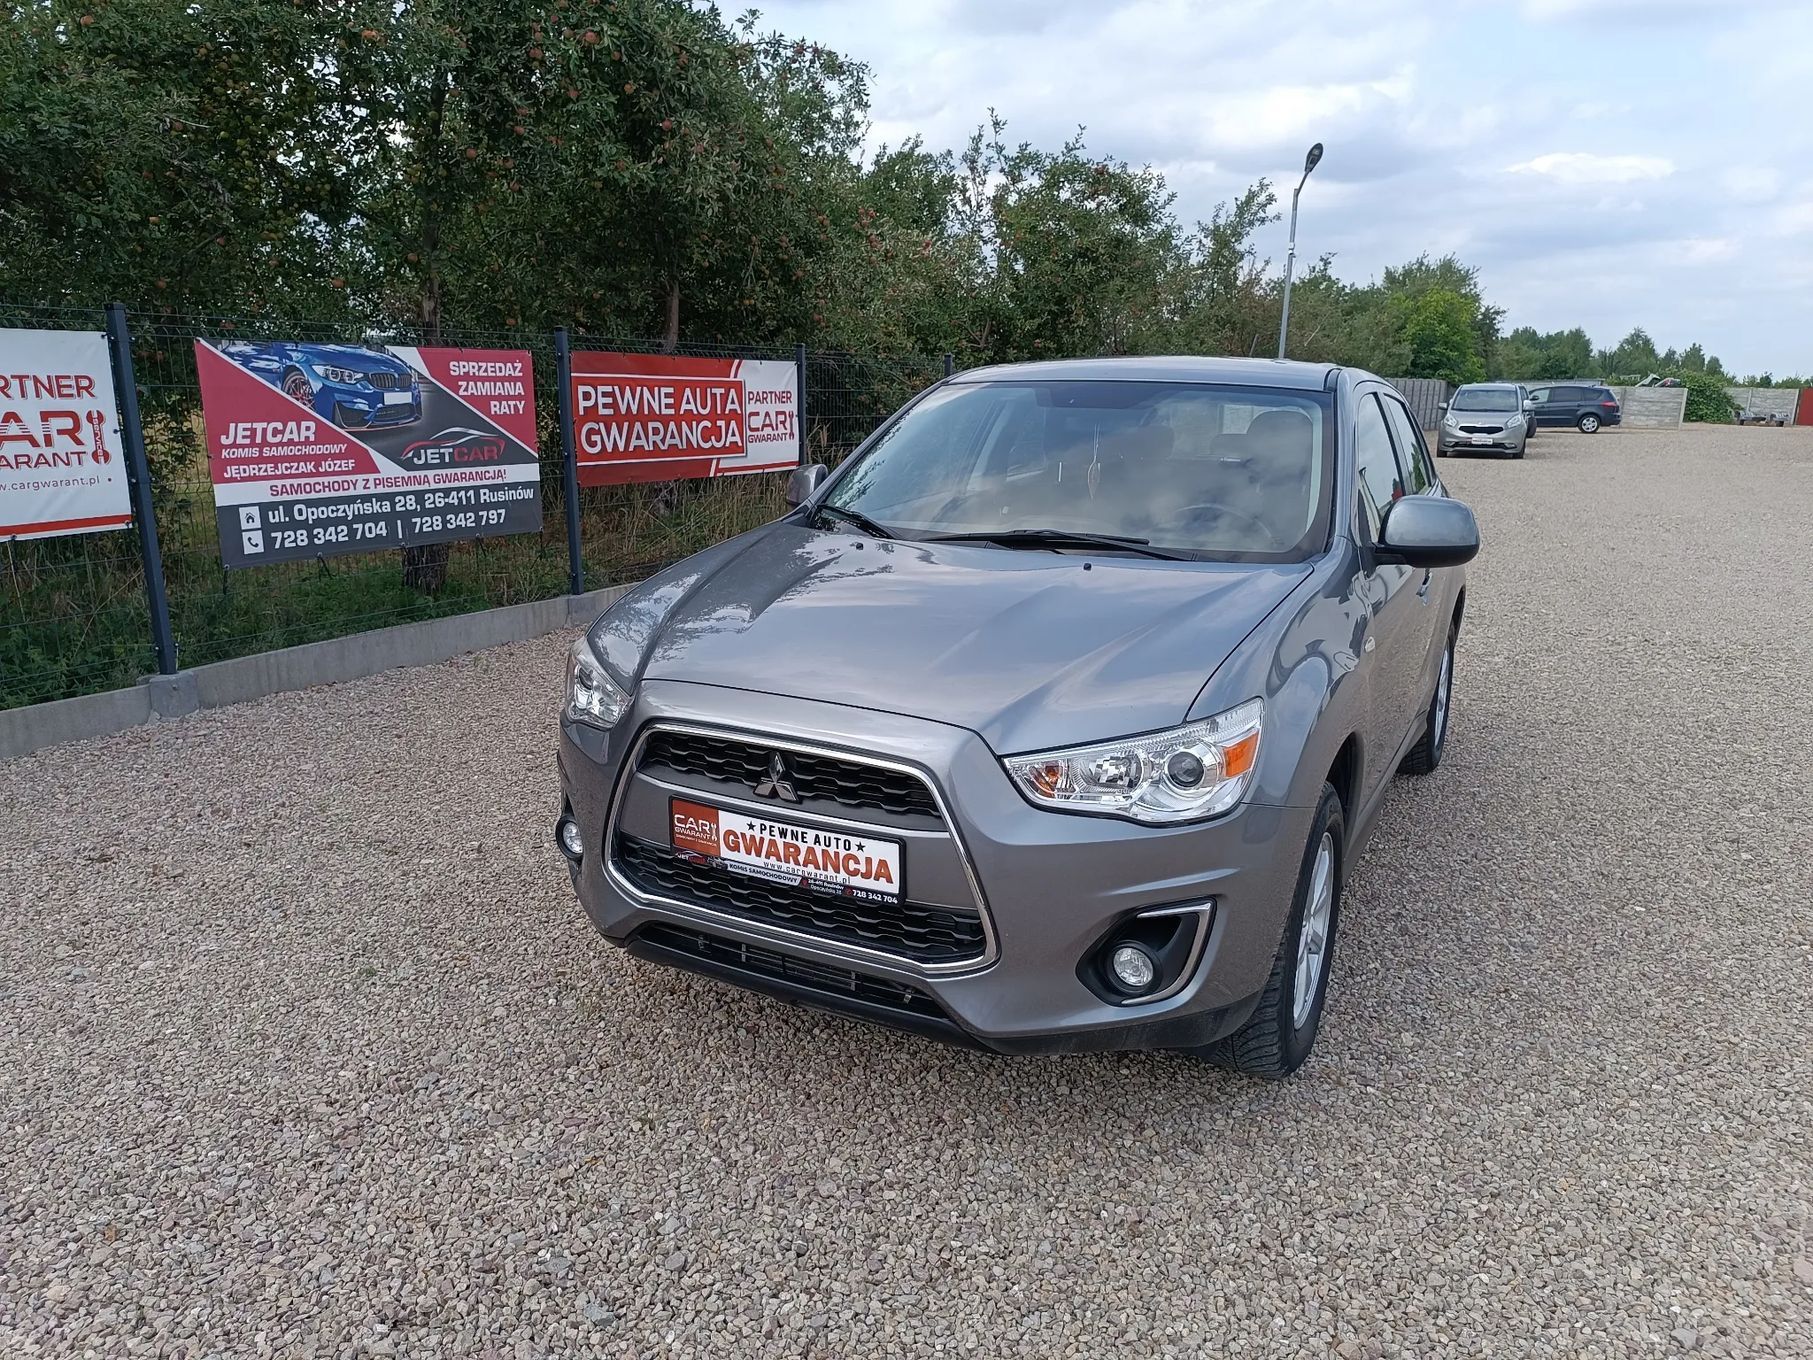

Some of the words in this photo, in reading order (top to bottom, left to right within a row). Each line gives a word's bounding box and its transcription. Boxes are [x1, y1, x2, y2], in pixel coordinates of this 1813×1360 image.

[449, 360, 523, 377] SPRZEDAŻ
[458, 381, 525, 396] ZAMIANA
[748, 391, 792, 405] PARTNER
[490, 401, 526, 415] RATY
[577, 385, 676, 416] PEWNE
[679, 387, 741, 416] AUTA
[748, 411, 788, 432] CAR
[220, 420, 317, 446] JETCAR
[580, 420, 743, 454] GWARANCJA
[748, 432, 788, 443] GWARANT
[221, 447, 260, 459] KOMIS
[262, 443, 348, 457] SAMOCHODOWY
[413, 445, 499, 465] JETCAR
[223, 461, 317, 480] JĘDRZEJCZAK
[318, 458, 356, 472] JÓZEF
[269, 478, 359, 497] SAMOCHODY
[362, 478, 371, 490] Z
[373, 473, 432, 489] PISEMNĄ
[433, 469, 507, 484] GWARANCJĄ!
[268, 505, 290, 523] ul.
[293, 498, 391, 524] Opoczyńska
[394, 495, 421, 512] 28,
[424, 490, 475, 509] 26-411
[479, 486, 534, 503] Rusinów
[270, 530, 309, 549] 728
[312, 525, 349, 545] 342
[352, 521, 388, 540] 704
[411, 516, 443, 533] 728
[446, 512, 476, 529] 342
[478, 509, 506, 526] 797
[674, 814, 711, 834] CAR
[674, 826, 711, 840] GWARANT
[759, 823, 808, 844] PEWNE
[813, 834, 852, 851] AUTO
[723, 829, 894, 884] GWARANCJA
[729, 863, 748, 872] KOMIS
[748, 867, 798, 884] SAMOCHODOWY
[852, 889, 867, 898] 728
[868, 891, 882, 901] 342
[883, 895, 898, 904] 704
